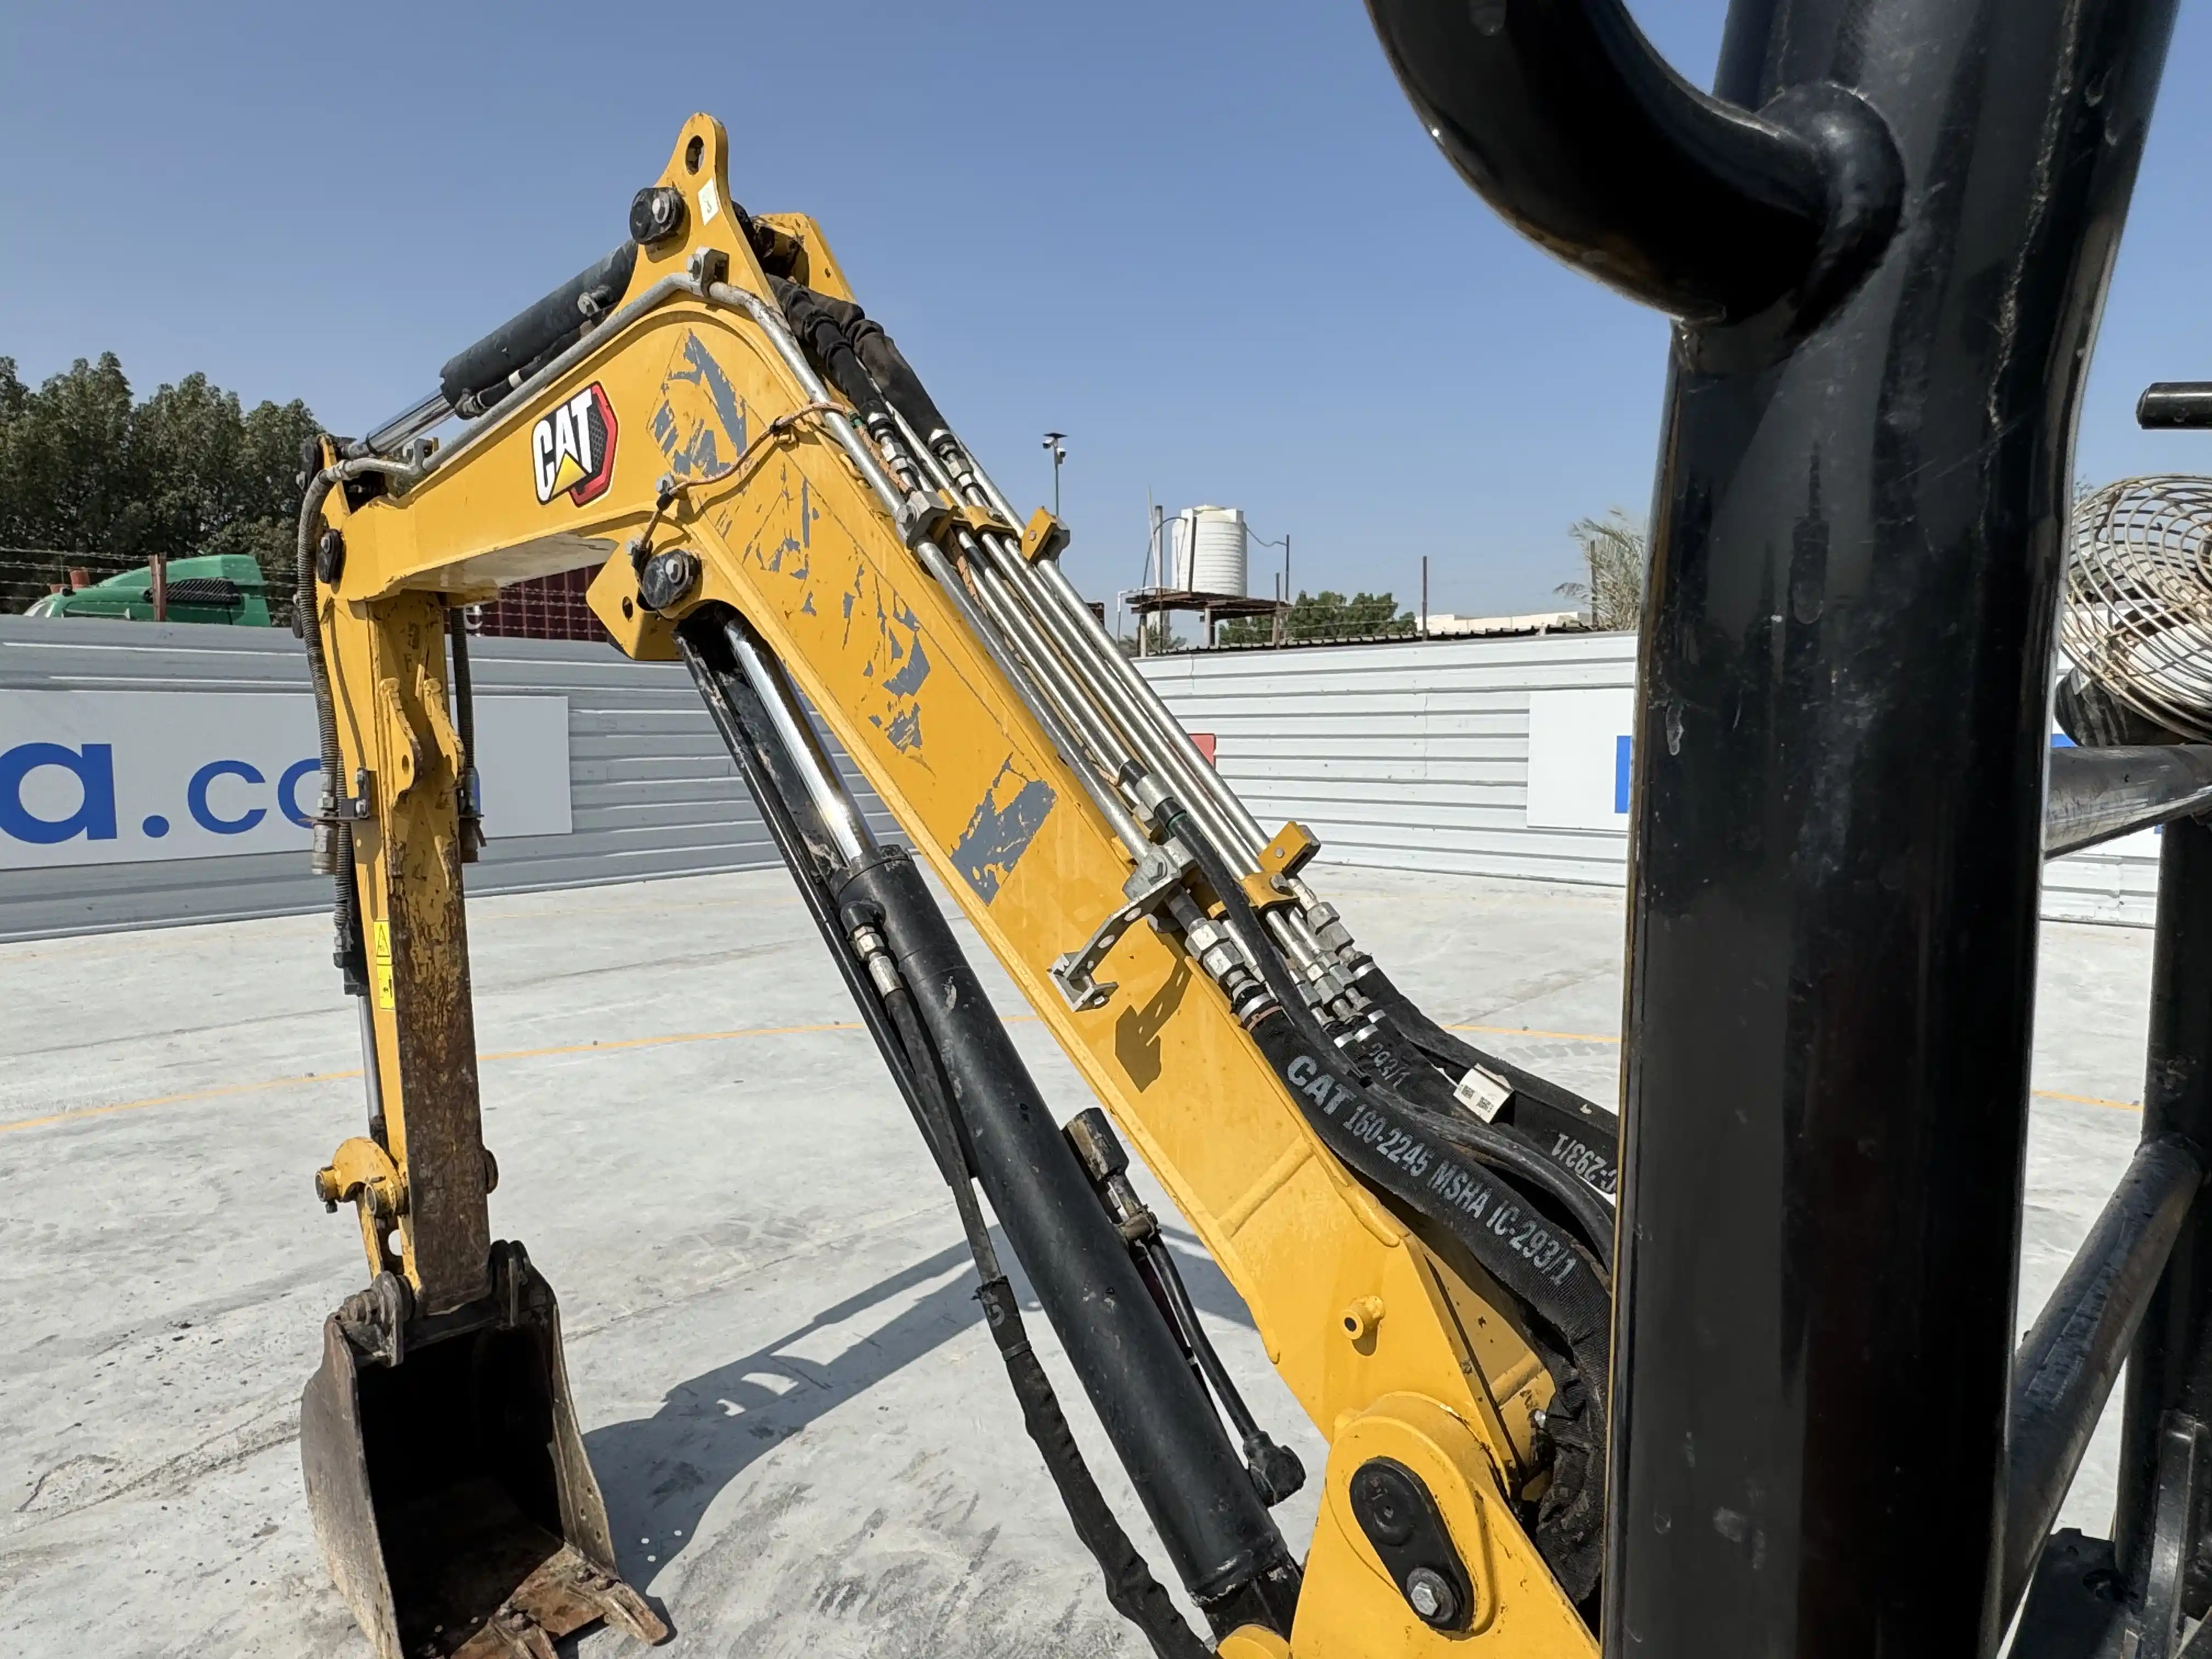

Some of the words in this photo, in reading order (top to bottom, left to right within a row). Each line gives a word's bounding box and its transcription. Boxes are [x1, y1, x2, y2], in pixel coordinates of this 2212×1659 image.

[533, 387, 592, 502] CAT
[1287, 1056, 1357, 1115] CAT
[1343, 1104, 1435, 1177] 160-2245
[1426, 1159, 1492, 1219] MSHA
[1486, 1200, 1577, 1286] IC-293/1
